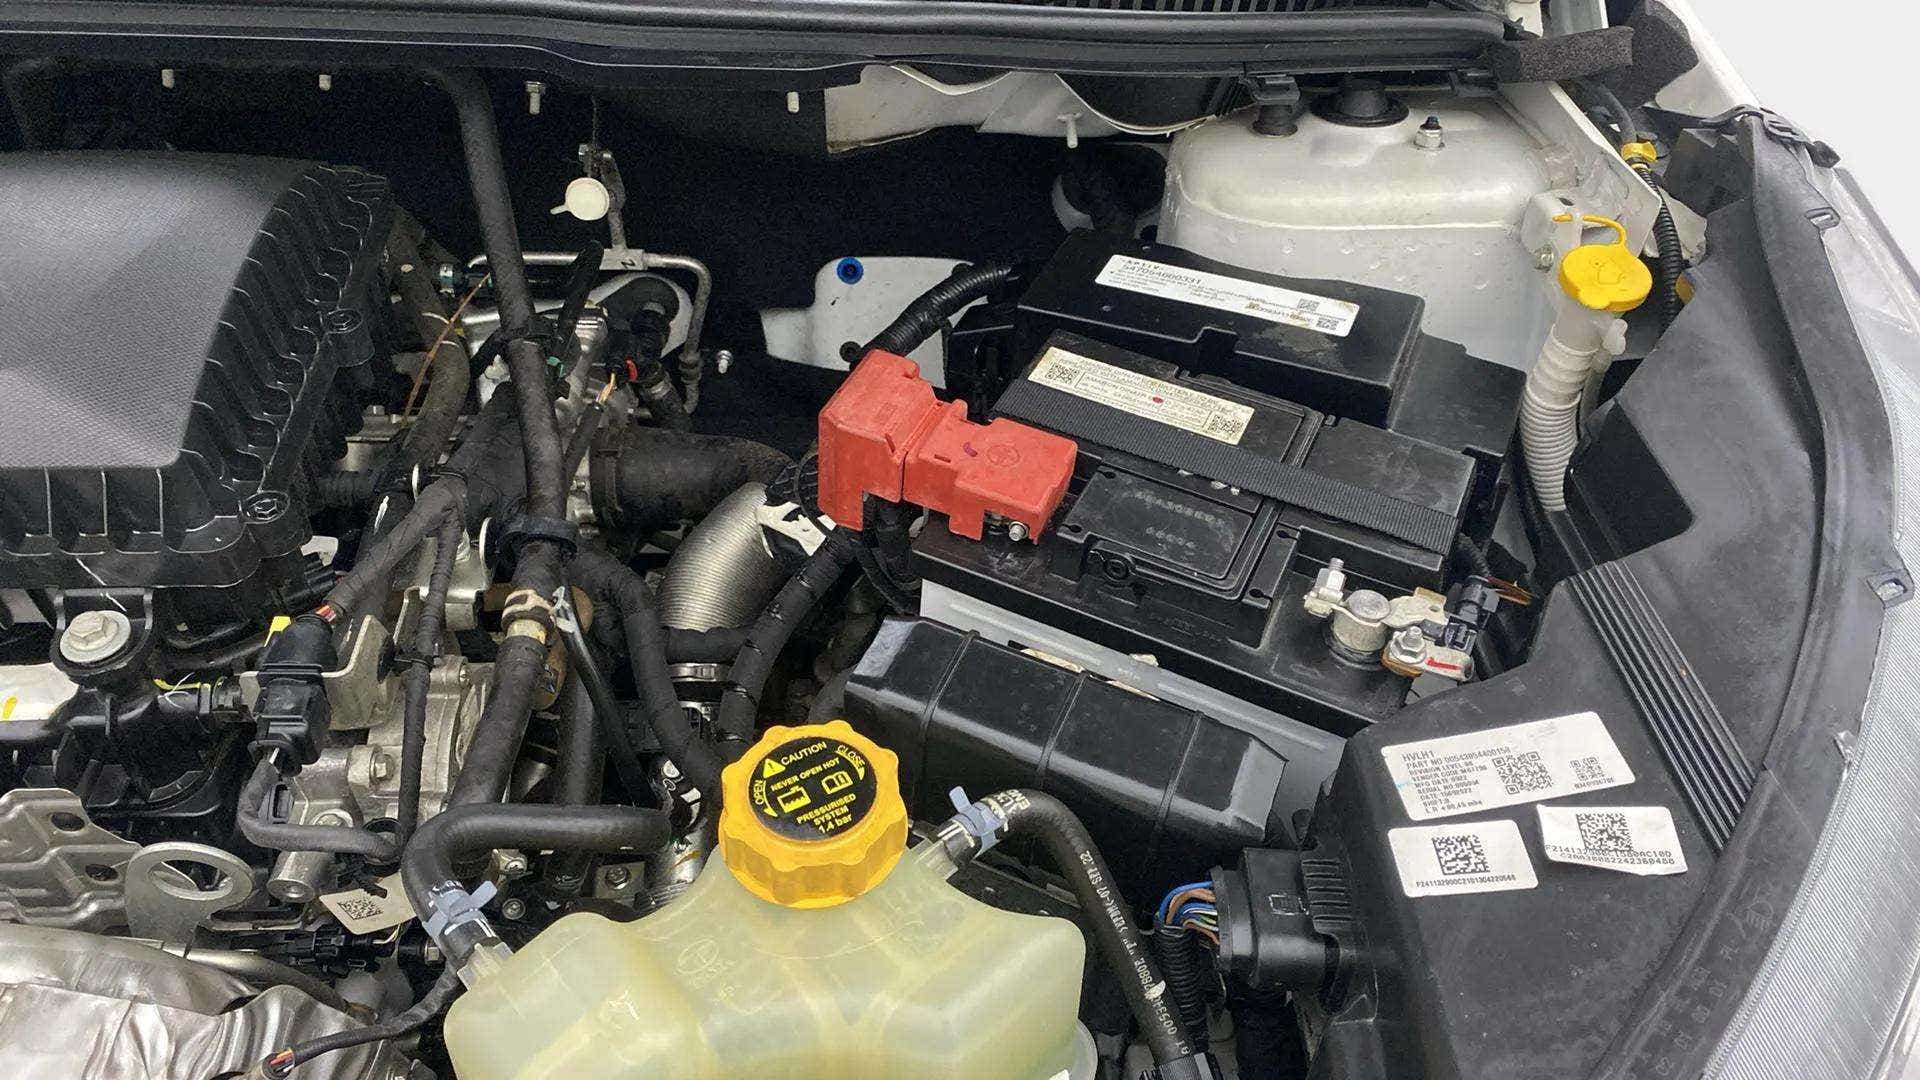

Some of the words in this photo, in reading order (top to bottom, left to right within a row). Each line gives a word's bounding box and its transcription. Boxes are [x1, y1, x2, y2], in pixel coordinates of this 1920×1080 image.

[781, 741, 827, 766] CAUTION
[837, 745, 866, 767] CLOSE
[770, 774, 800, 792] NEVER
[799, 764, 823, 780] OPEN
[823, 757, 840, 769] HOT
[753, 779, 764, 805] OPEN
[796, 793, 856, 824] PRESSURISED
[813, 805, 849, 826] SYSTEM
[836, 814, 852, 827] bar
